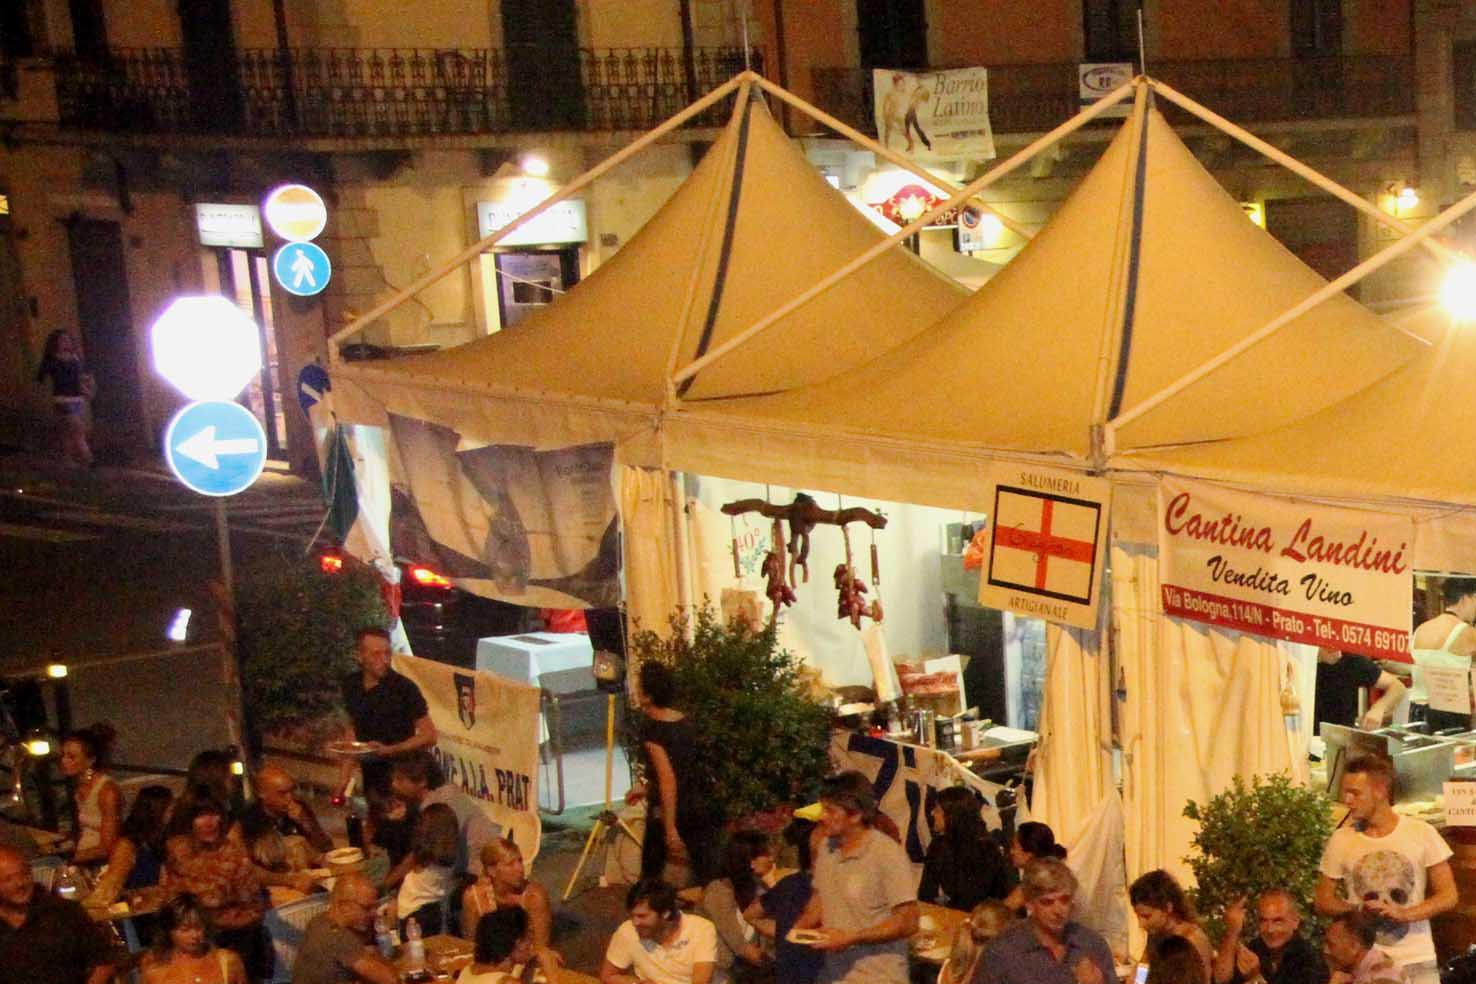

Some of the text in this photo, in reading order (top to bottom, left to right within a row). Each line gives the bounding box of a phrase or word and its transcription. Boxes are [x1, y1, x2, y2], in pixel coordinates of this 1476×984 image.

[934, 72, 985, 96] Barrio
[1020, 473, 1080, 496] SALUMERIA
[1164, 492, 1407, 575] Cantina Landini
[1207, 555, 1354, 606] Vendita Vino
[1164, 587, 1181, 608] Via
[1272, 610, 1304, 635] Prato
[1341, 624, 1371, 647] 0574
